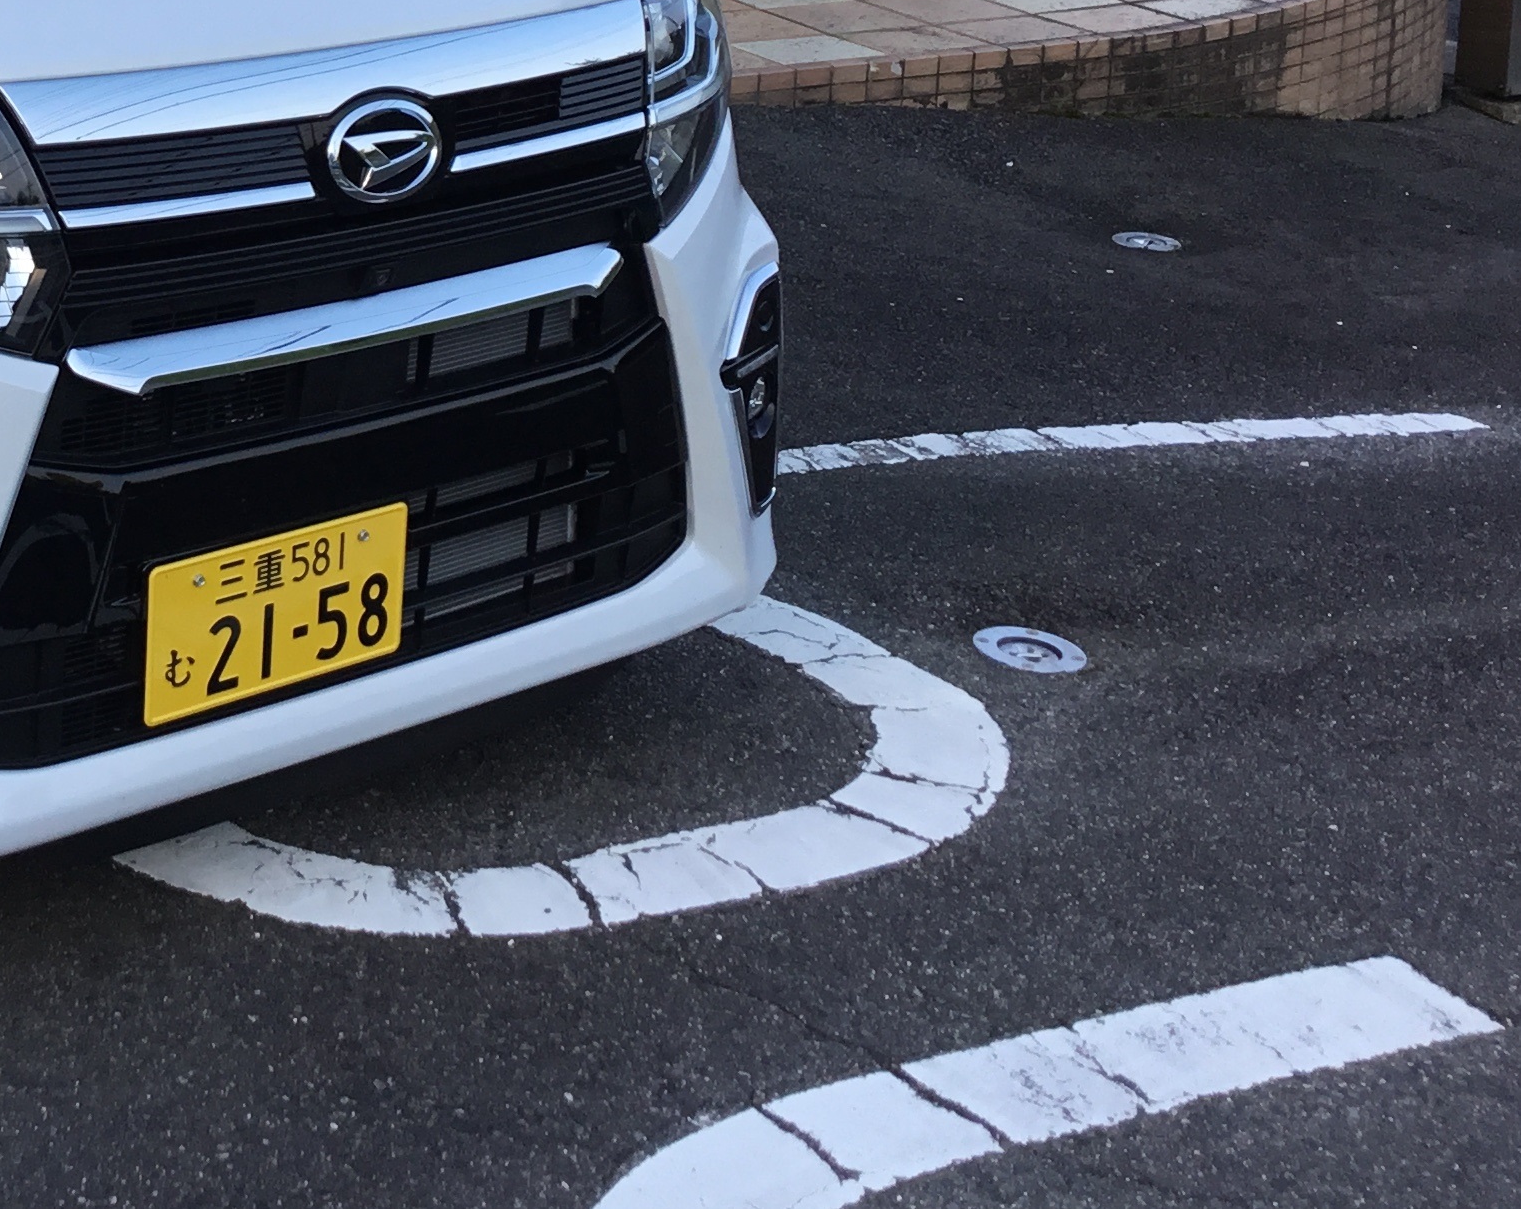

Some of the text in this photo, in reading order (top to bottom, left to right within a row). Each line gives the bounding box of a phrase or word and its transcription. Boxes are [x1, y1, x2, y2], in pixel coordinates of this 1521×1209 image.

[215, 531, 346, 605] 三重 581
[165, 572, 389, 697] む 21-58
